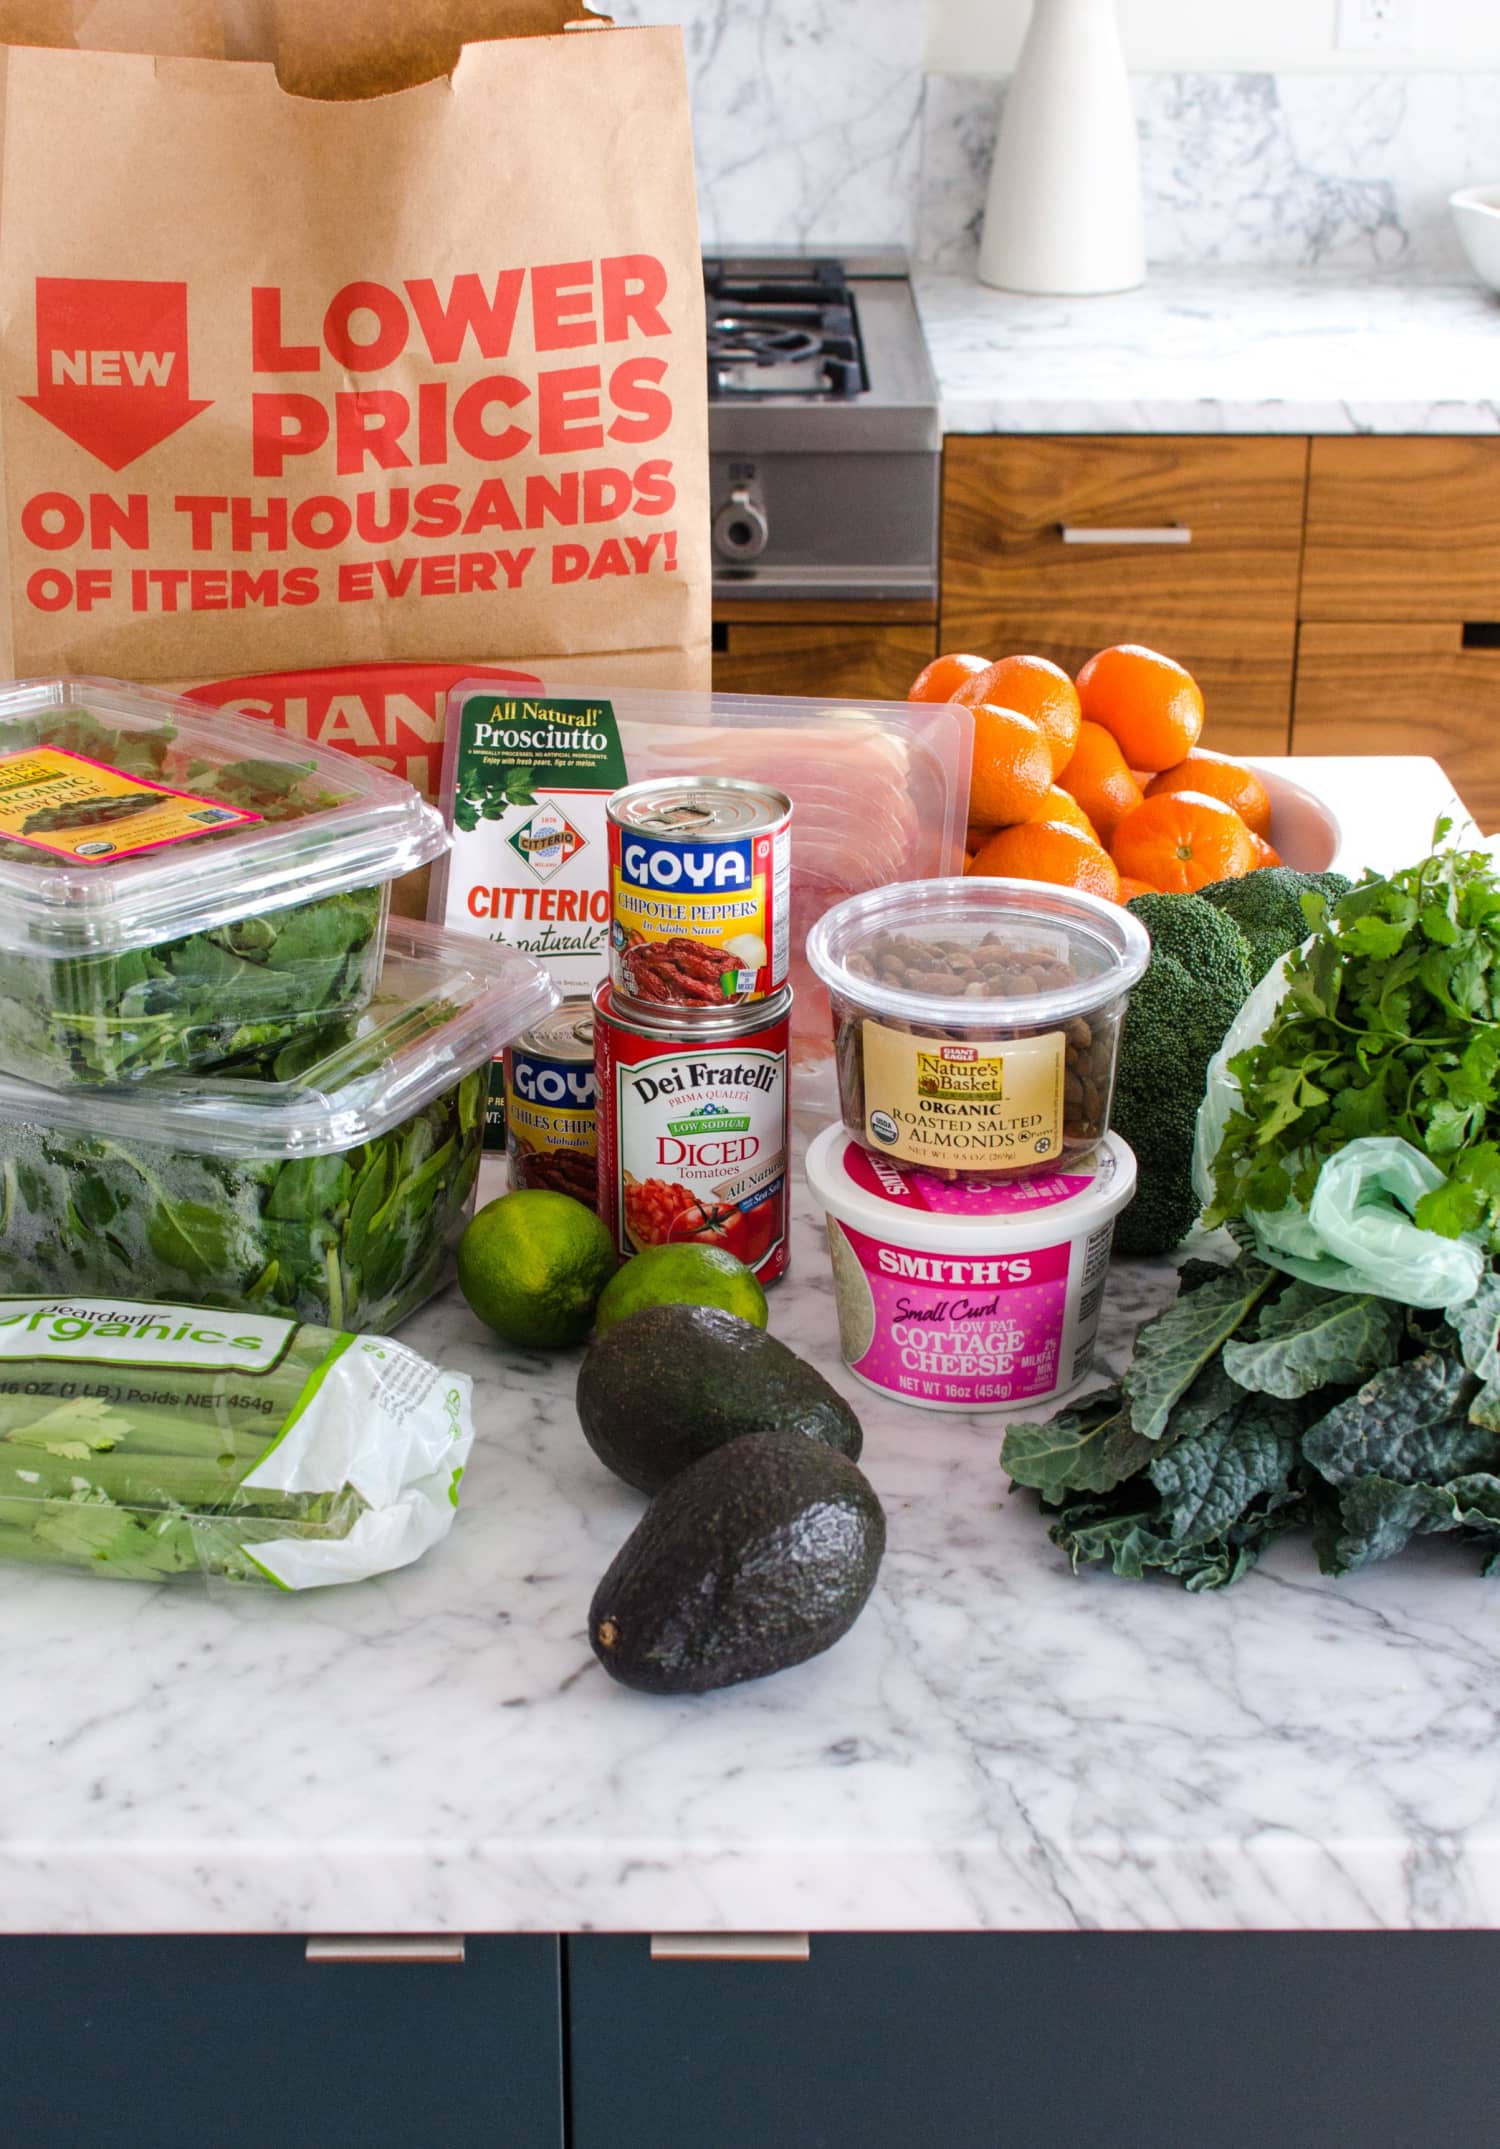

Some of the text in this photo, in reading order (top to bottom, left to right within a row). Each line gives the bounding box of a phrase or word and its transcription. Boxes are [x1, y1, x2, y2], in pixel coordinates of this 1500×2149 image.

[251, 254, 672, 373] LOWER
[51, 350, 176, 387] NEW
[252, 357, 673, 477] PRICES
[21, 460, 677, 552] ON THOUSANDS
[26, 531, 678, 612] OF ITEMS EVERY DAY!
[213, 691, 447, 746] GIAN
[489, 702, 599, 727] All Natural!
[473, 723, 608, 751] Prosciutto
[483, 756, 501, 766] Enjoy
[516, 757, 532, 766] fresh
[0, 776, 94, 804] RGANIC
[521, 833, 574, 849] CITTERIO
[625, 844, 746, 887] GOYA
[467, 885, 609, 923] CITTERIO
[618, 893, 758, 921] CHIPOTLE PEPPERS
[516, 924, 601, 952] naturale
[642, 920, 723, 936] In Adobo Sauce
[922, 1057, 999, 1077] Nature's
[515, 1063, 595, 1104] GOY
[632, 1063, 777, 1104] Dei Fratelli
[940, 1076, 998, 1091] Basket
[668, 1092, 704, 1108] PRIMA
[920, 1100, 1001, 1116] ORGANIC
[511, 1104, 550, 1131] CHILES
[673, 1119, 744, 1133] LOW SODIUM
[892, 1108, 972, 1132] ROASTED
[977, 1114, 1042, 1132] SALTED
[656, 1136, 759, 1167] DICED
[909, 1128, 1015, 1149] ALMONDS
[677, 1165, 740, 1180] Tomatoes
[727, 1181, 745, 1200] All
[877, 1248, 1032, 1285] SMITH'S
[893, 1296, 999, 1323] Small Curd
[0, 1309, 264, 1350] rganics
[890, 1322, 1025, 1356] COTTAGE
[950, 1319, 1016, 1333] LOW FAT
[900, 1349, 1014, 1378] CHEESE
[899, 1375, 920, 1394] NET
[922, 1379, 941, 1396] WT
[944, 1382, 971, 1398] 16oz
[974, 1381, 1012, 1398] (454g)
[127, 1389, 180, 1406] Poids
[184, 1393, 224, 1409] NET
[227, 1394, 275, 1415] 454g
